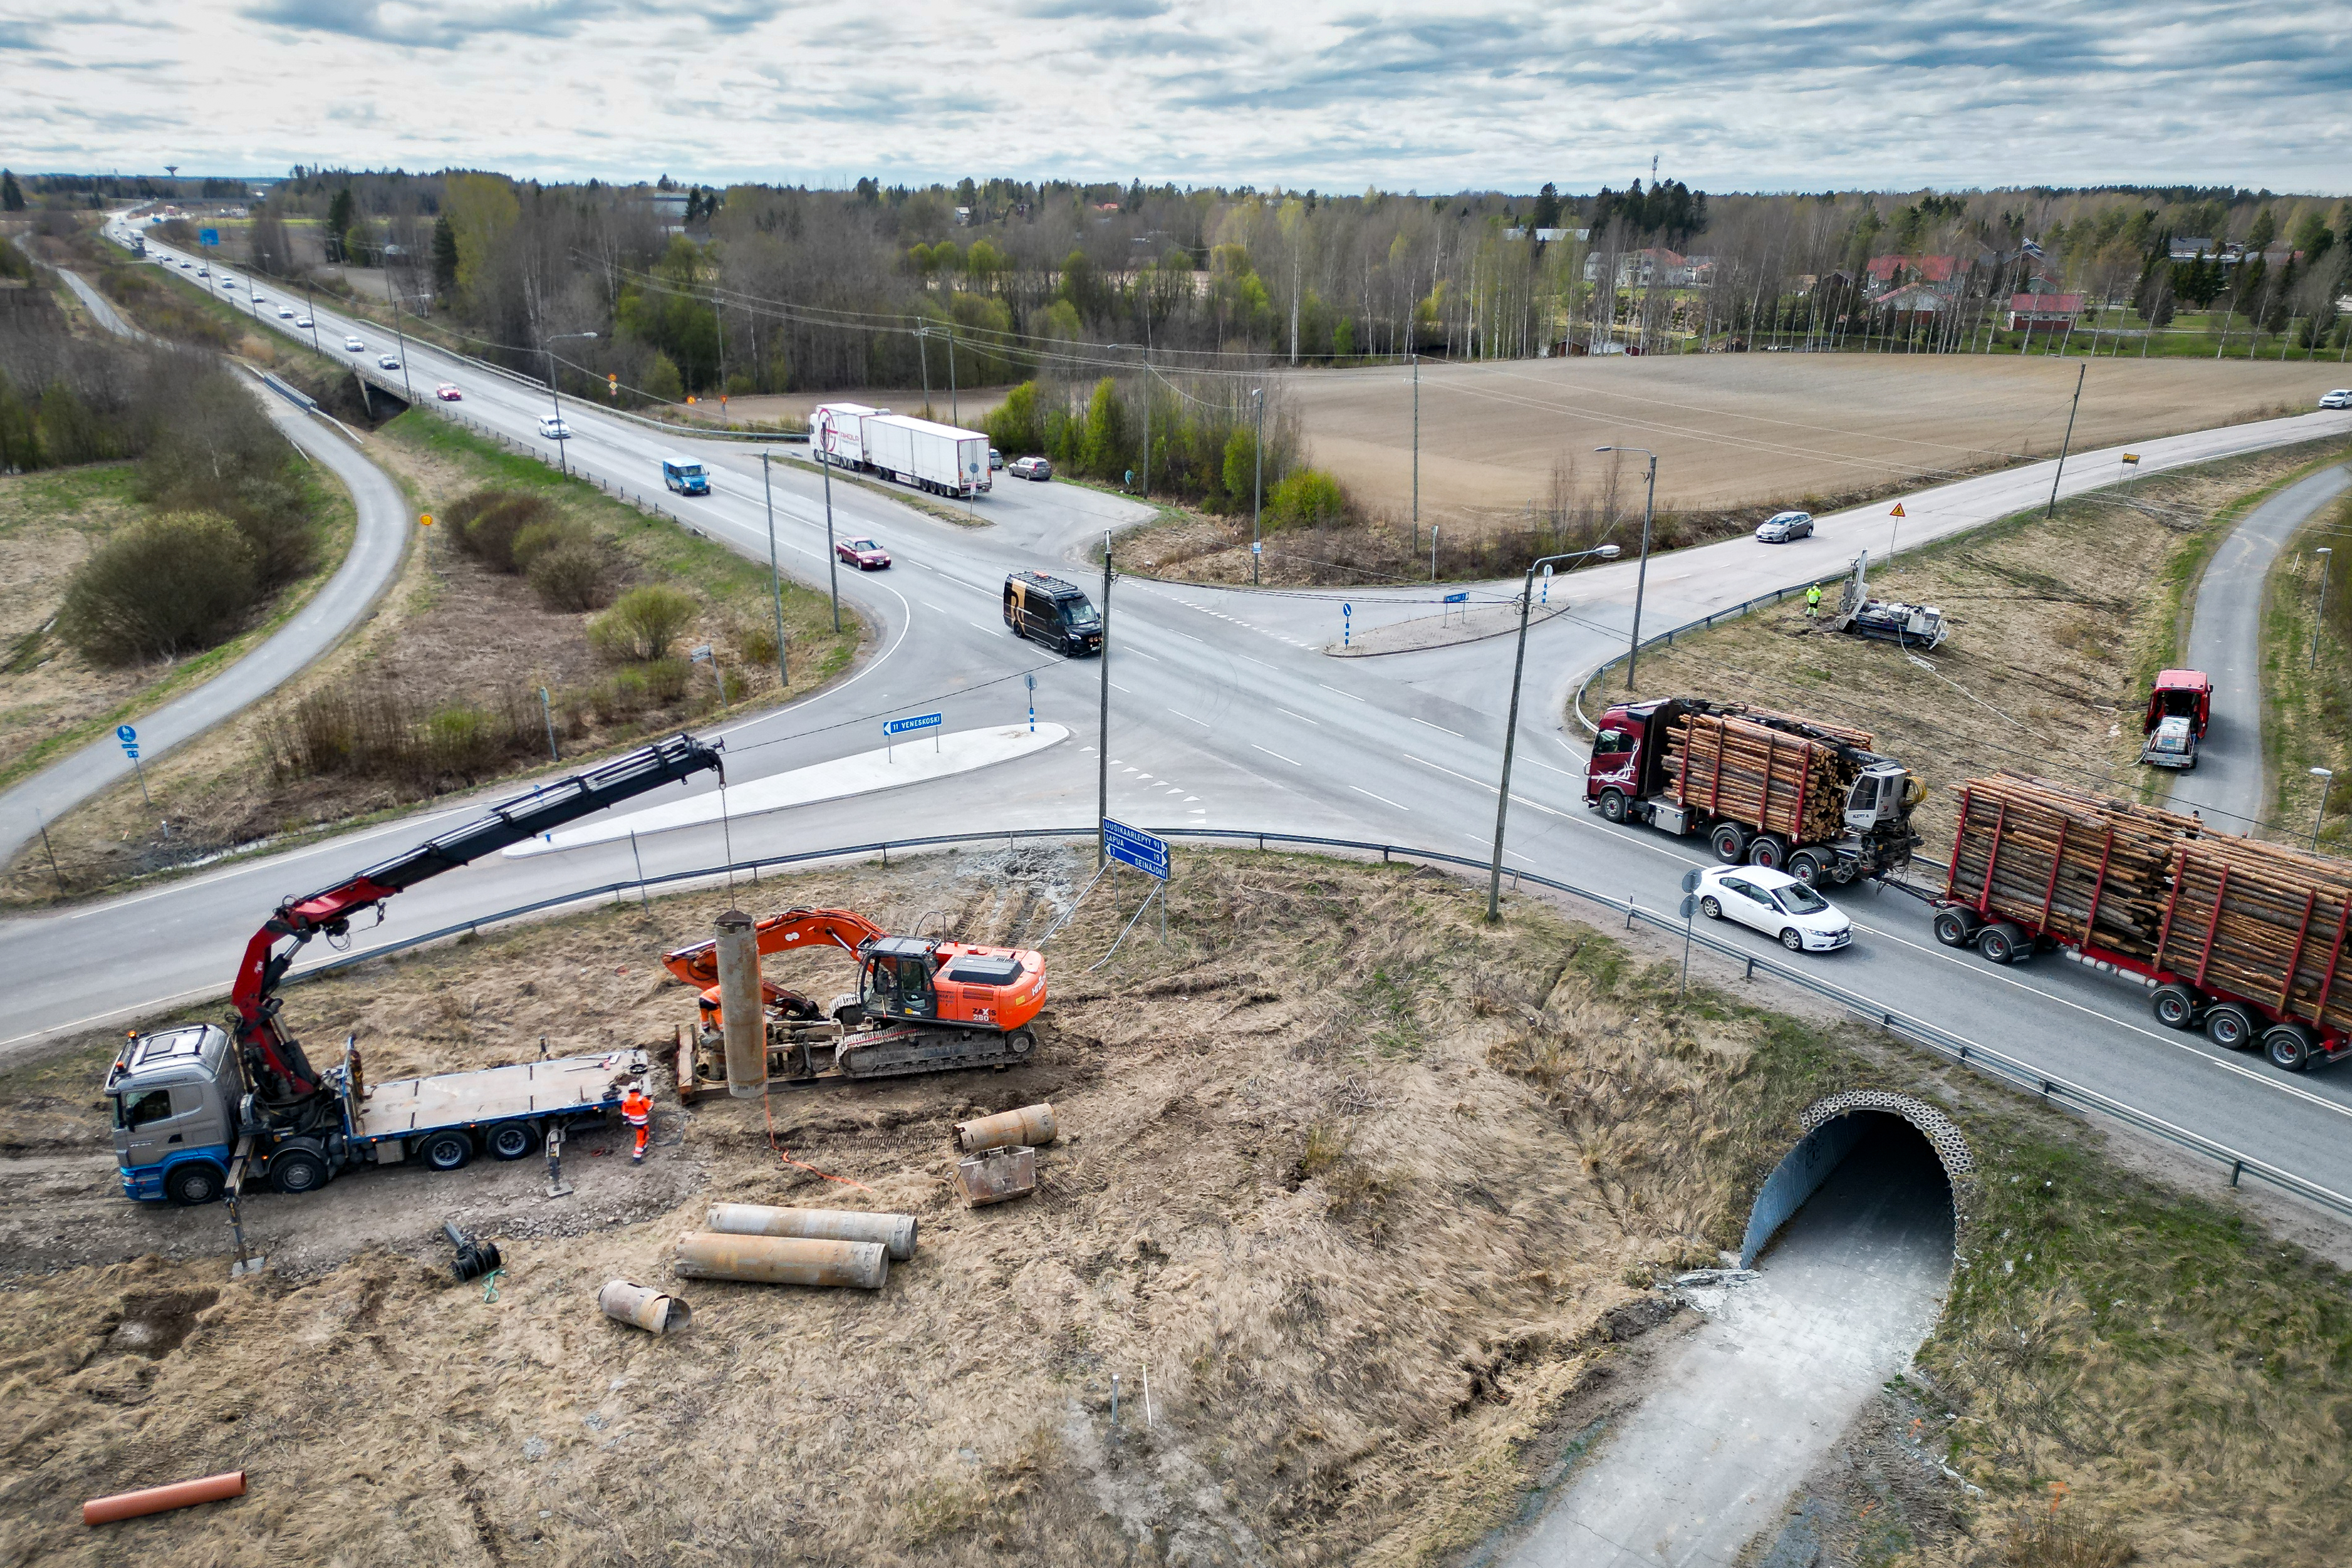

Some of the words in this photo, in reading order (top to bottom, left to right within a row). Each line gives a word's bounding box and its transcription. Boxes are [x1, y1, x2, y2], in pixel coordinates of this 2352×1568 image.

[901, 716, 940, 729] VENESKOSKI
[1105, 821, 1151, 845] UUSIKAARLEPYY
[1153, 840, 1160, 849] 91
[1106, 833, 1124, 847] LAPUA
[1153, 852, 1160, 862] 19
[1112, 847, 1115, 855] 7
[1135, 858, 1165, 877] SEINÄJOKI
[972, 1008, 997, 1016] ZAXIS
